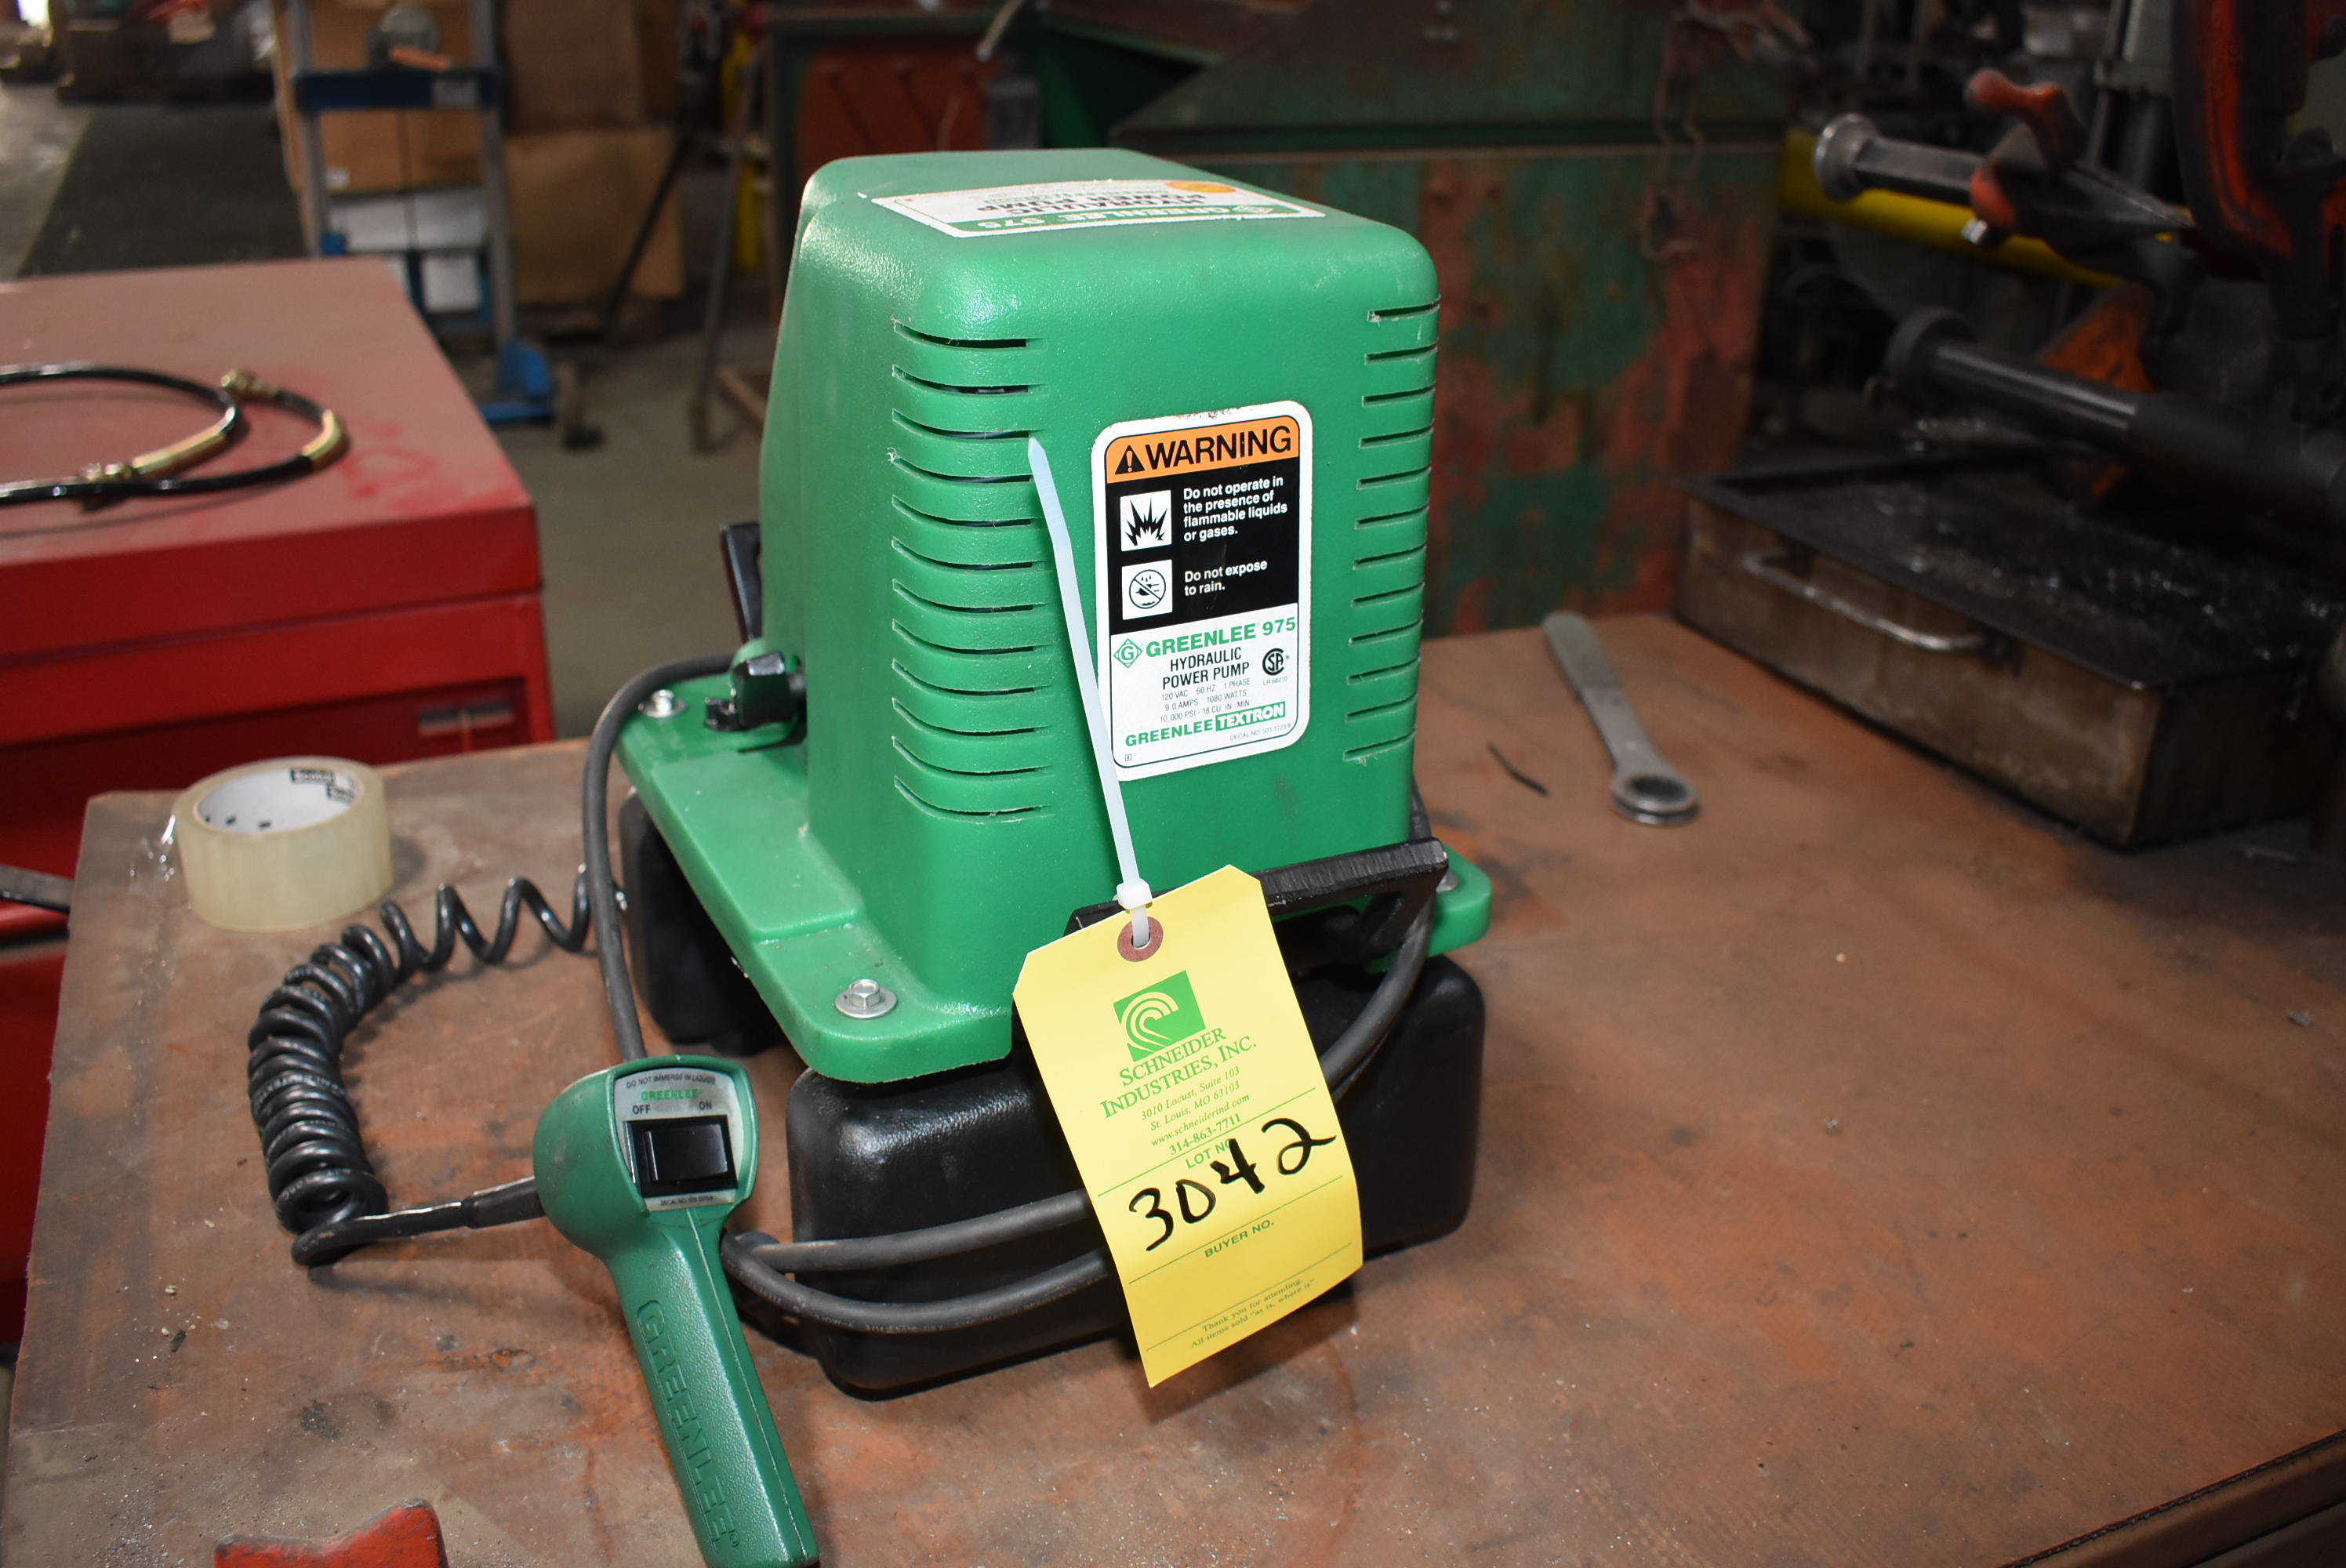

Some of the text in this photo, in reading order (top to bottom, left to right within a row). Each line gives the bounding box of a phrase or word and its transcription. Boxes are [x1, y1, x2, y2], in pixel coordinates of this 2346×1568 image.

[1145, 426, 1291, 470] WARNING
[1183, 475, 1284, 500] Do not operate in
[1183, 490, 1275, 514] the presence of
[1183, 502, 1287, 528] flammable liquids
[1183, 525, 1238, 543] or gases.
[1184, 561, 1268, 583] Do not expose
[1184, 580, 1226, 596] to rain.
[1146, 623, 1256, 658] GREENLEE
[1262, 616, 1296, 636] 975
[1163, 662, 1250, 690] POWER PUMP
[1170, 647, 1242, 672] HYDRAULIC
[1161, 692, 1173, 701] 120
[1175, 690, 1189, 699] VAC
[1196, 686, 1205, 695] 60
[1207, 684, 1215, 693] HZ
[1229, 677, 1251, 688] PHASE
[1178, 699, 1199, 709] AMPS
[1207, 694, 1222, 703] 1080
[1224, 689, 1247, 700] WATTS
[1125, 702, 1284, 746] GREENLEE TEXTRON
[1185, 710, 1196, 719] PSI
[1119, 1027, 1227, 1087] SCHNEIDER
[1099, 1055, 1218, 1119] INDUSTRIES,
[1141, 1066, 1240, 1121] 3010 Locust, Suite 103
[632, 1100, 713, 1115] OFF ON
[1150, 1080, 1240, 1131] St. Louis, MO 63103
[1151, 1094, 1250, 1147] www.schneiderind.com
[1169, 1112, 1241, 1156] 314-863-7711
[1185, 1148, 1211, 1170] LOT
[1129, 1117, 1337, 1252] 3042
[1204, 1220, 1274, 1258] BUYER NO.
[1191, 1338, 1204, 1348] All
[1207, 1326, 1229, 1341] items
[1231, 1315, 1248, 1329] sold
[1277, 1288, 1302, 1304] where
[1202, 1316, 1229, 1333] Thank
[1231, 1307, 1247, 1320] you
[1249, 1299, 1261, 1309] for
[636, 1299, 735, 1550] GREENLEE
